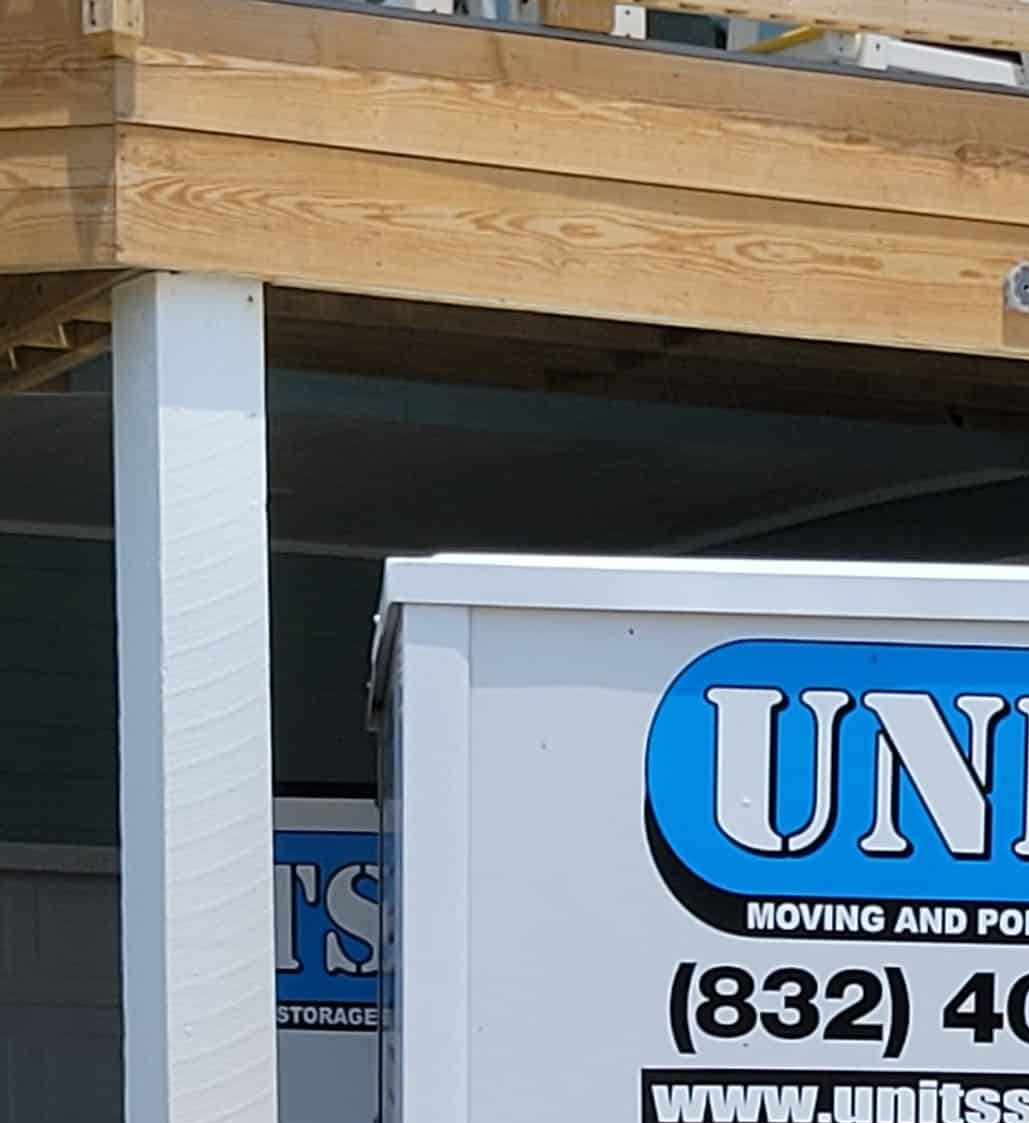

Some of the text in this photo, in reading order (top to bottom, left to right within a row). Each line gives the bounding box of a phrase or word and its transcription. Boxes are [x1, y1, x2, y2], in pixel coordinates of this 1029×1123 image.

[747, 902, 885, 933] MOVING
[894, 906, 968, 935] AND
[277, 1005, 378, 1026] STORAGE
[669, 962, 910, 1058] (832)
